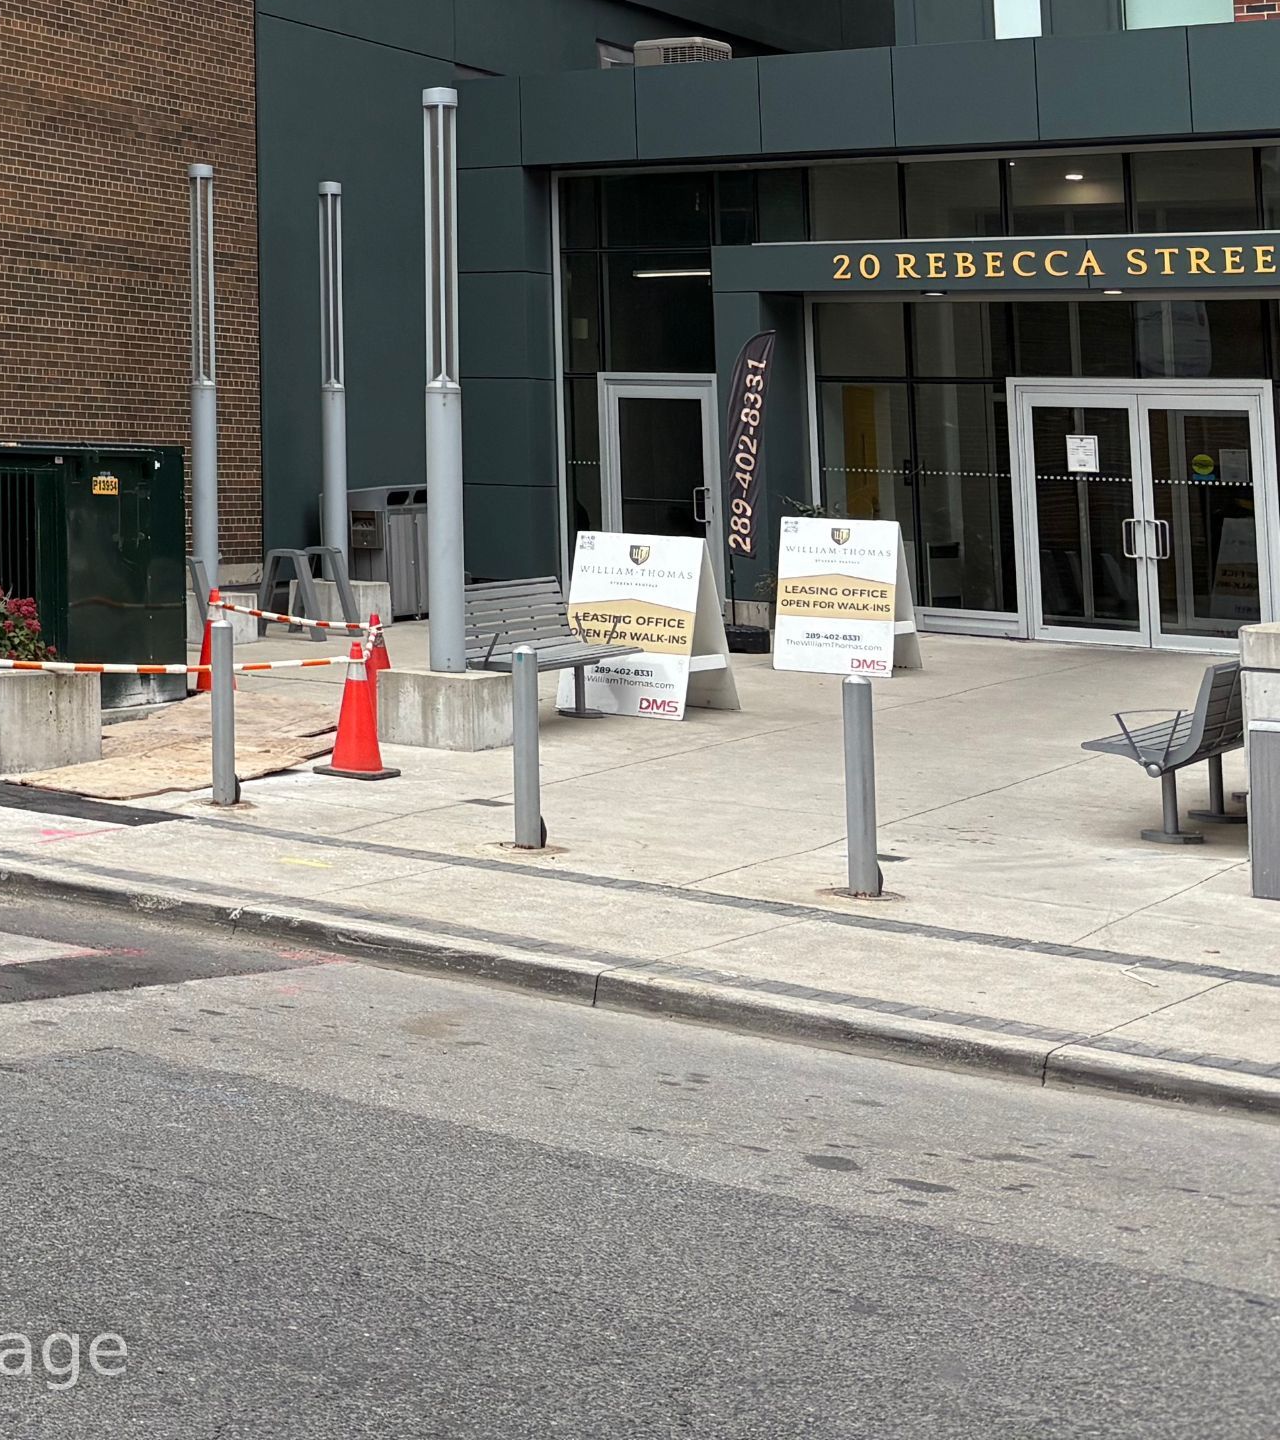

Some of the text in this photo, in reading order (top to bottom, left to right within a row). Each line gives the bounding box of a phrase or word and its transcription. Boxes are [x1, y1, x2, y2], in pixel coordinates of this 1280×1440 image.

[833, 254, 881, 280] 20
[895, 249, 1106, 279] REBECCA
[728, 358, 767, 553] 289-402-8331
[785, 545, 892, 557] WILLIAM THOMAS
[580, 565, 693, 580] WILLIAM THOMAS
[784, 585, 888, 599] LEASING OFFICE
[781, 599, 891, 613] OPEN FOR WALK-INS
[636, 616, 685, 629] OFFICE
[604, 630, 627, 640] FOR
[629, 631, 687, 645] WALK-INS
[805, 632, 860, 641] 289-402-8331
[786, 638, 882, 651] TheWilliamThomas.com
[594, 665, 653, 677] 289-402-8331
[850, 658, 888, 671] DMS
[586, 675, 675, 690] WilliamThomas.com
[639, 697, 680, 713] DMS
